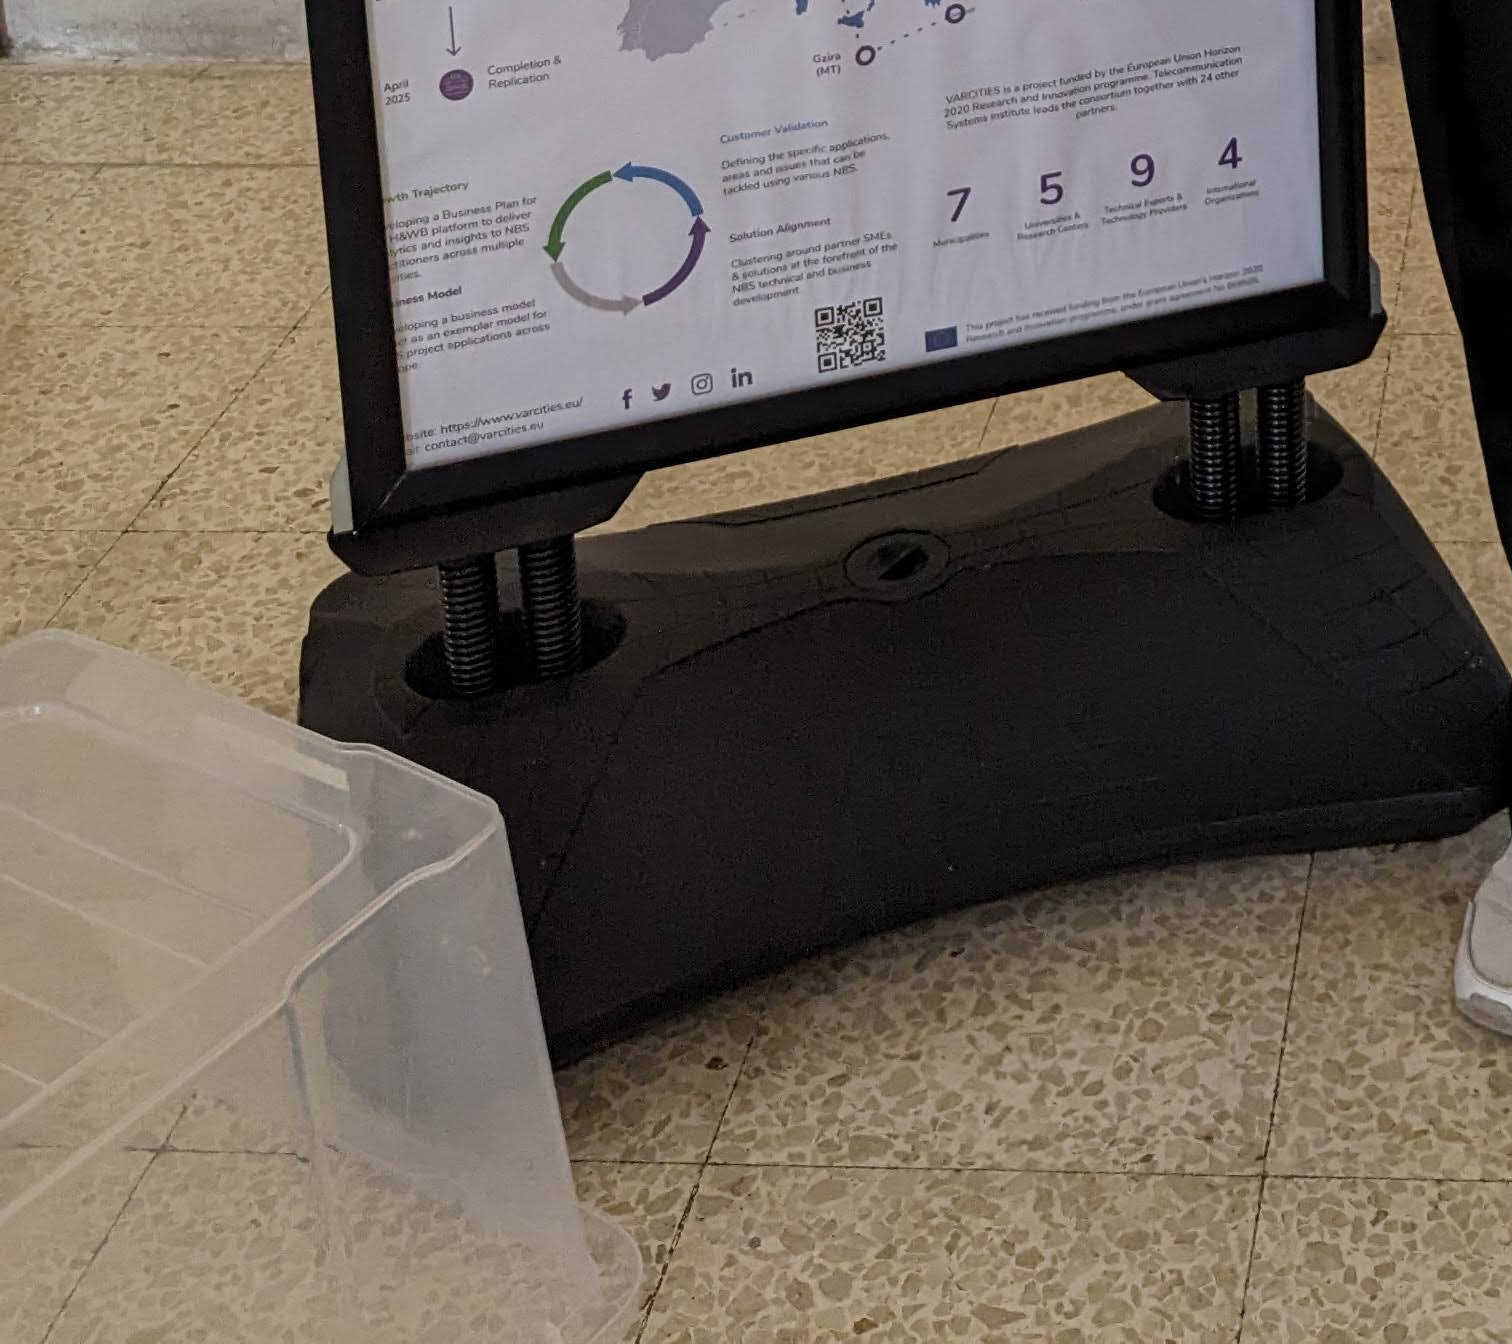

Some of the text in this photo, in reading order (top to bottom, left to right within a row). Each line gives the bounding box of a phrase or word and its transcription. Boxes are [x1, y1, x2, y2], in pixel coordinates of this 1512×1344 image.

[487, 55, 562, 76] Completion &
[812, 52, 841, 63] Gzira
[816, 65, 841, 77] (MT)
[384, 79, 409, 93] April
[488, 71, 550, 90] Replication
[944, 104, 970, 118] 2020
[972, 96, 1018, 111] Research
[1020, 93, 1039, 103] and
[1042, 85, 1092, 101] Innovation
[1153, 56, 1243, 79] Telecommunication
[385, 93, 411, 106] 2025
[946, 69, 1240, 130] Systems Institute leads the consortium together with 24 other
[719, 119, 828, 145] Customer Validation
[1218, 137, 1243, 169] 4
[1131, 153, 1155, 187] 9
[412, 181, 469, 200] Trajectory
[1040, 171, 1064, 205] 5
[947, 187, 971, 222] 7
[729, 216, 831, 244] Solution Alignment
[442, 238, 525, 261] across multiple
[730, 251, 783, 269] Clustering
[785, 243, 821, 259] around
[823, 237, 861, 254] partner
[425, 419, 544, 453] contact@varcities.eu
